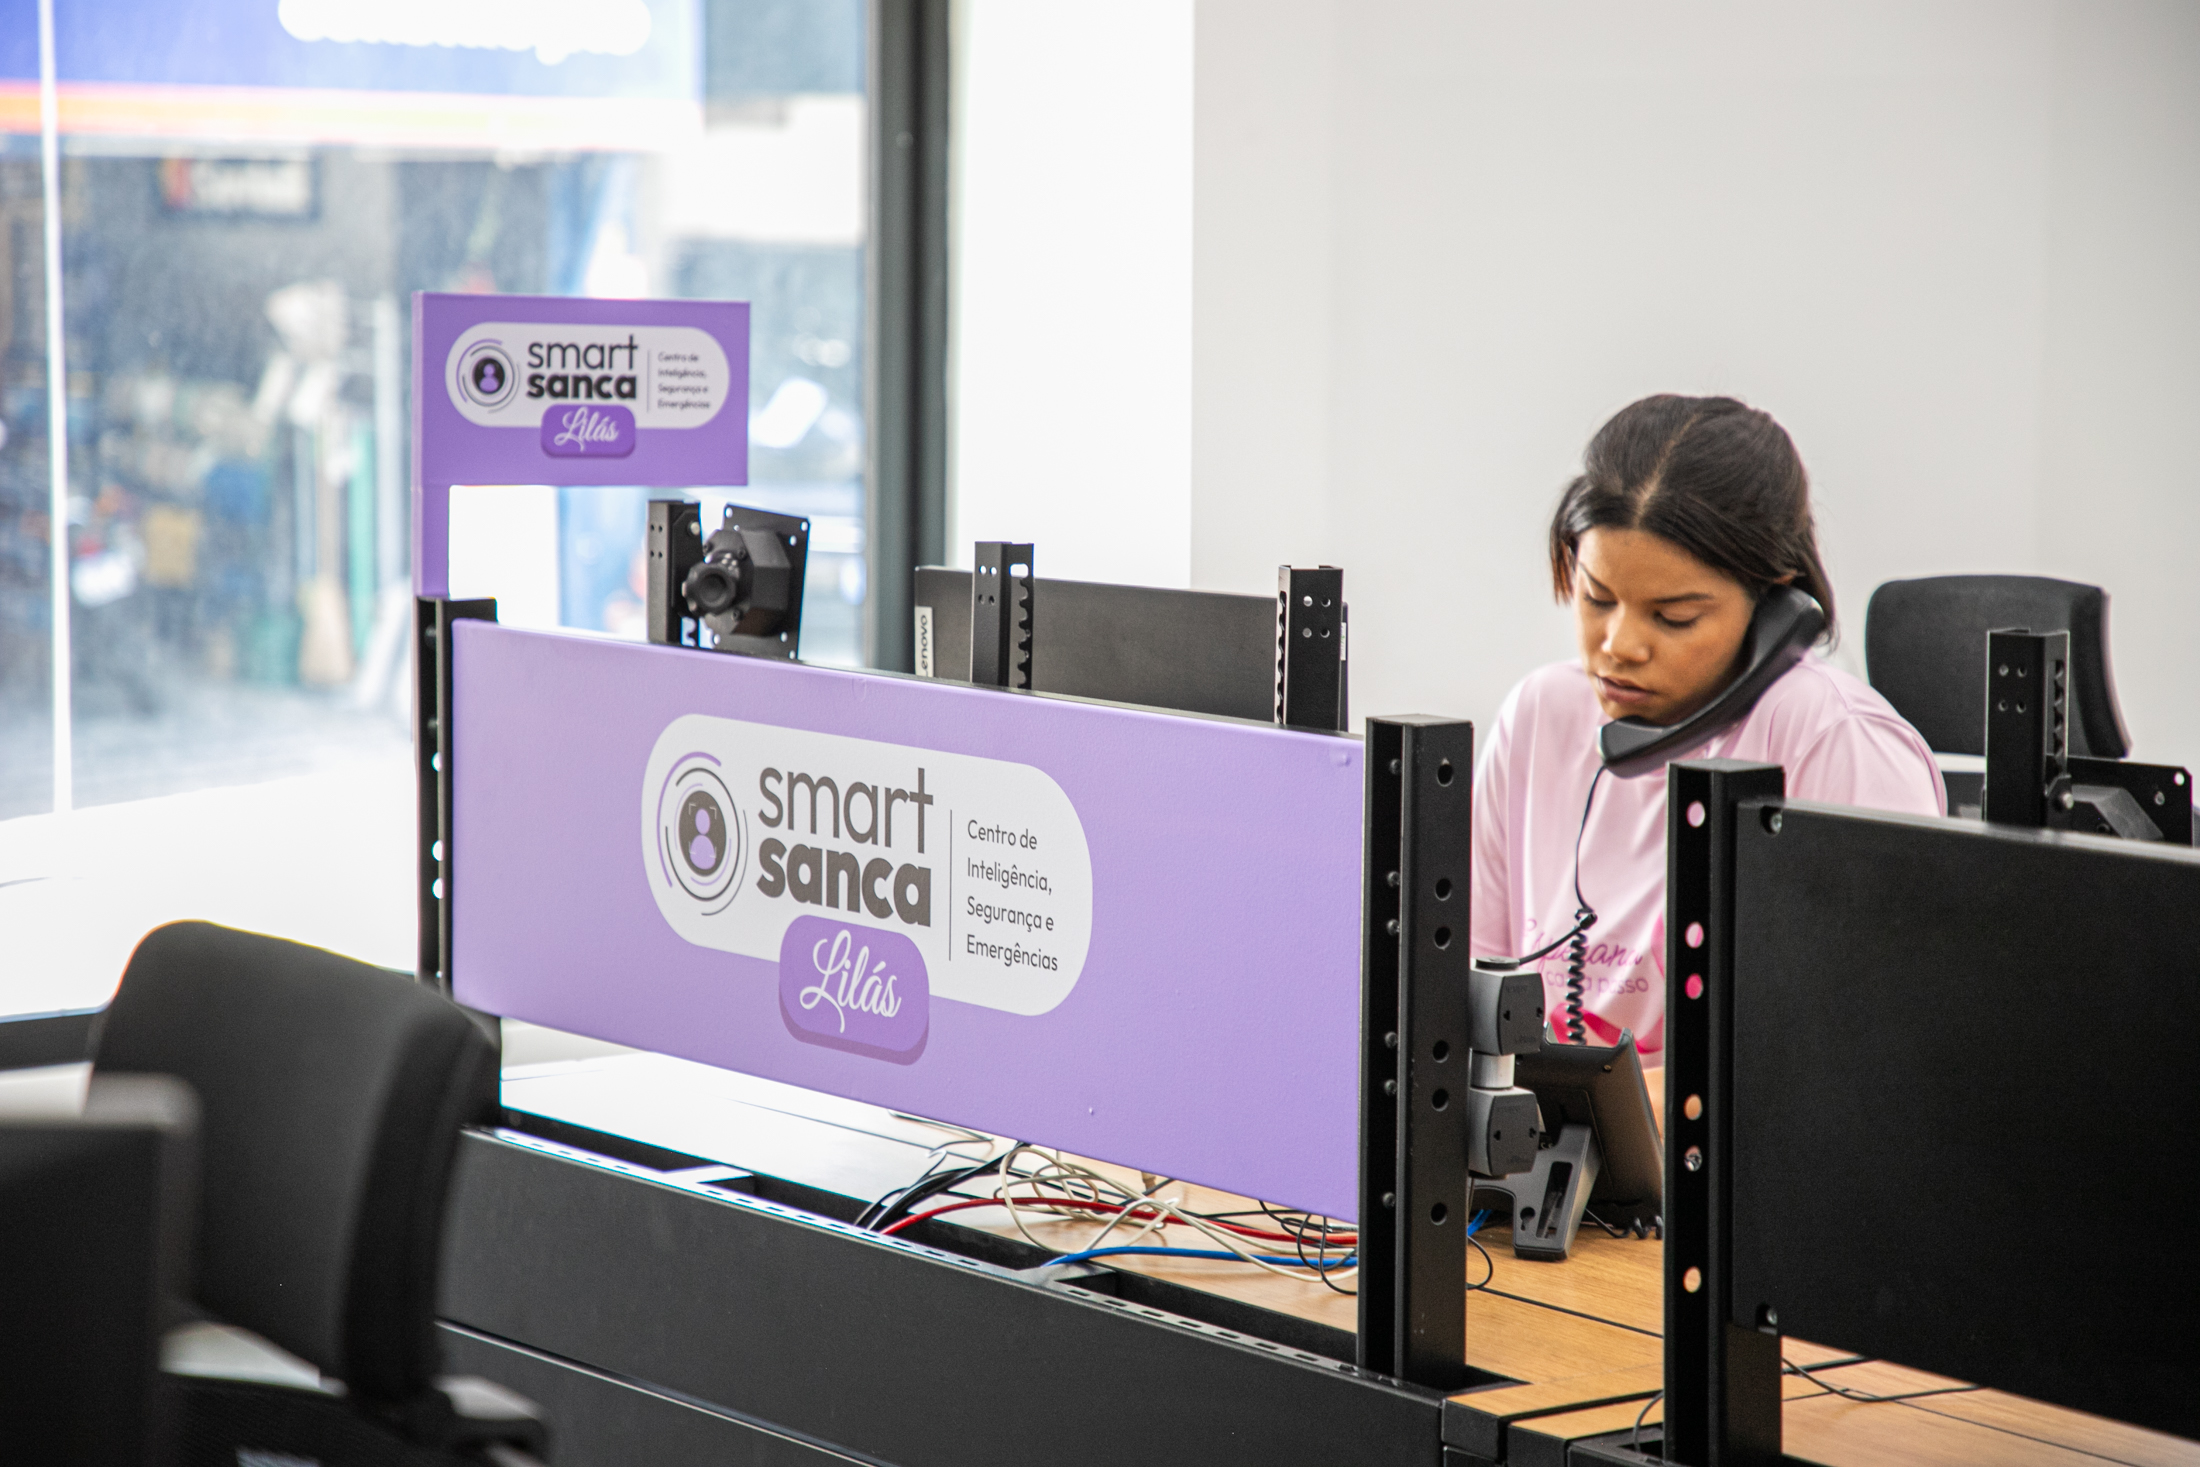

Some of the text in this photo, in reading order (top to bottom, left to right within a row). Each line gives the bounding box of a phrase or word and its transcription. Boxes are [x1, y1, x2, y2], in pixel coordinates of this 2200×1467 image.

[527, 334, 639, 370] smart
[657, 351, 699, 363] Centro de
[526, 374, 637, 400] sanca
[657, 398, 711, 411] Emergências
[554, 406, 620, 452] Lilás
[758, 766, 935, 854] smart
[967, 819, 1038, 850] Centro de
[756, 836, 932, 928] sanca
[967, 857, 1053, 896] Inteligência,
[967, 895, 1055, 933] Segurança e
[966, 933, 1059, 972] Emergências
[800, 929, 902, 1034] Lilás
